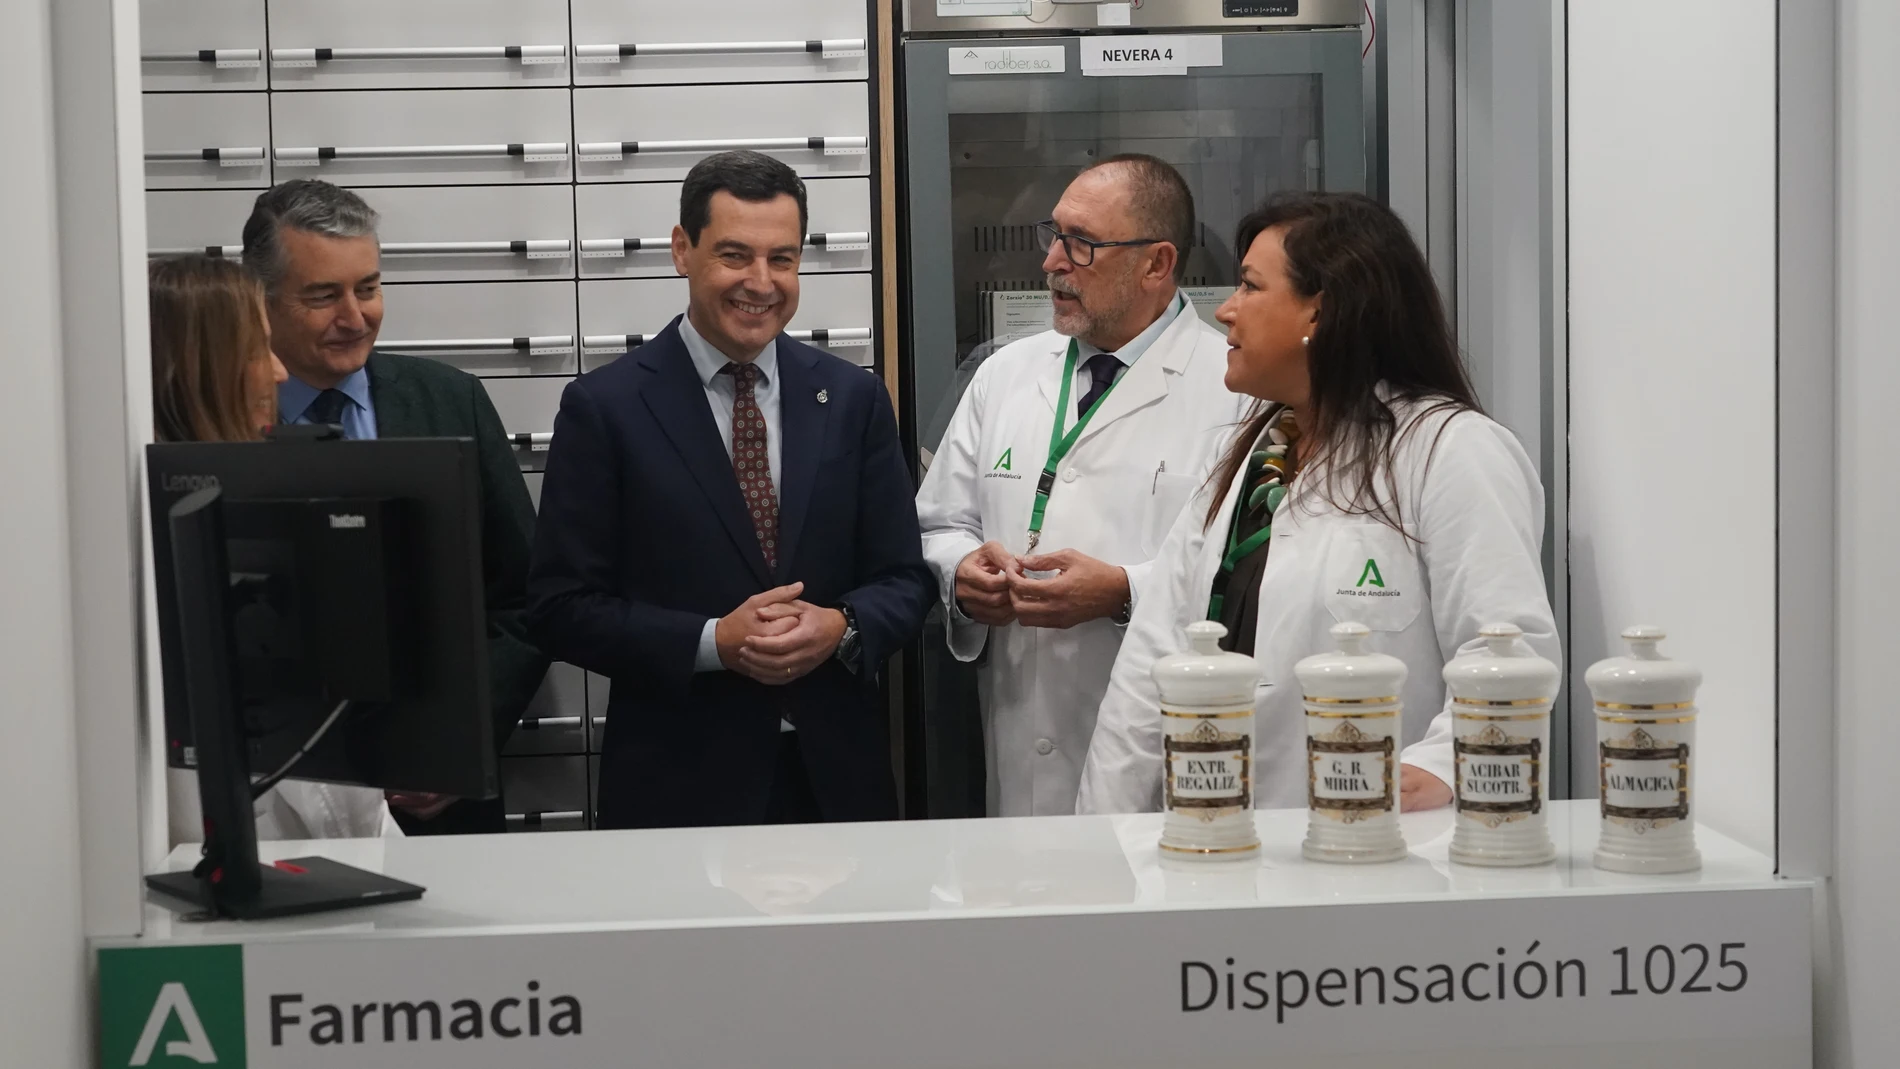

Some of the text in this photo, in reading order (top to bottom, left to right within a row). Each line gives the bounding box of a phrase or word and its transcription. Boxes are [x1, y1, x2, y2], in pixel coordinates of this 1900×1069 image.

[1103, 48, 1173, 62] NEVERA 4
[1336, 588, 1401, 597] Junta de Andalucía
[1187, 760, 1231, 774] EXTR.
[1332, 761, 1365, 776] G. R.
[1469, 763, 1521, 778] ACIBAR
[1323, 776, 1375, 792] MIRRA.
[1466, 780, 1524, 795] SUCOTR.
[1610, 774, 1675, 792] ALMACIGA
[1180, 940, 1749, 1024] Dispensación 1025
[269, 980, 583, 1046] Farmacia
